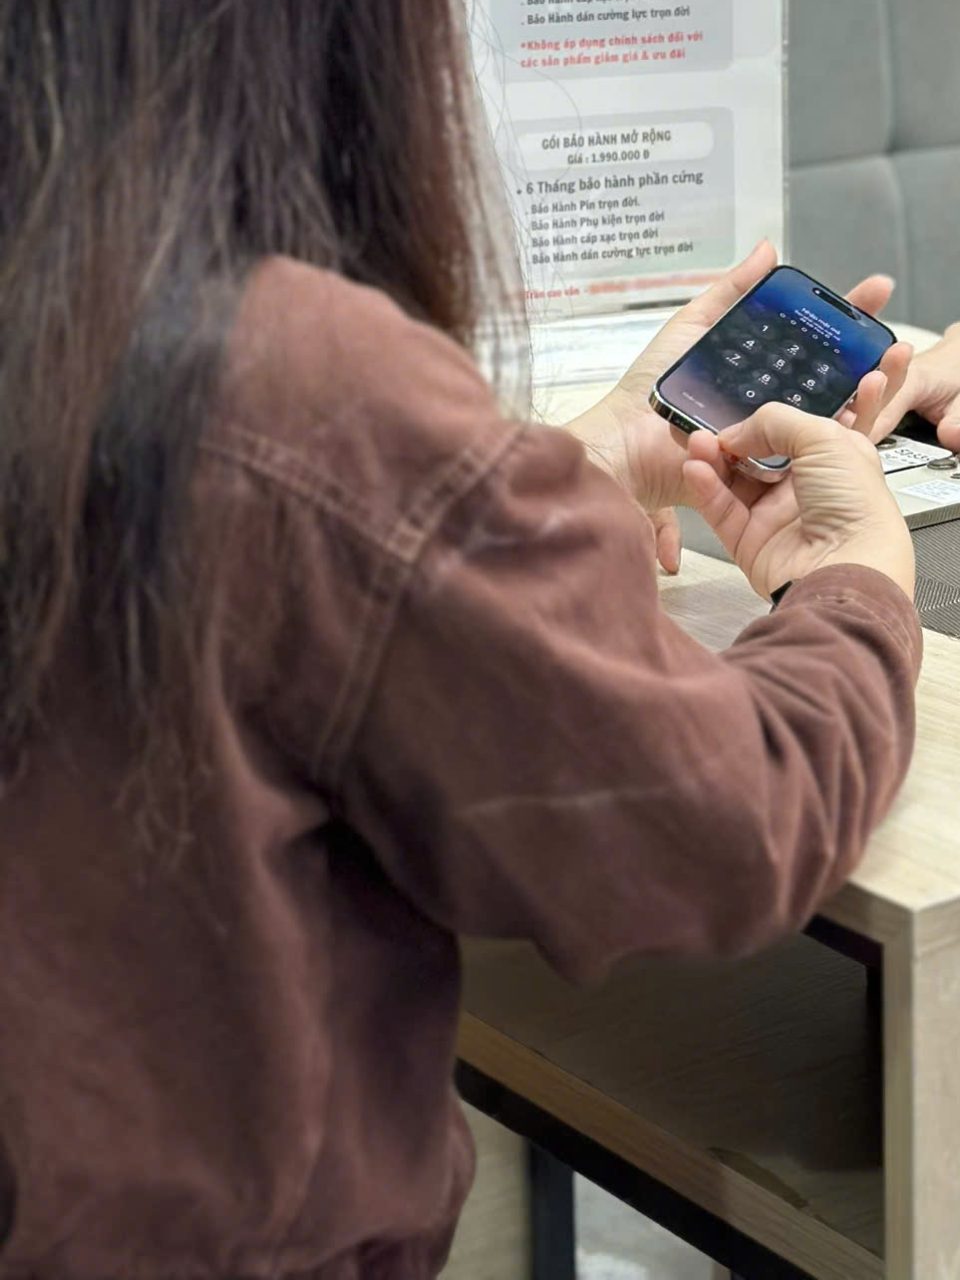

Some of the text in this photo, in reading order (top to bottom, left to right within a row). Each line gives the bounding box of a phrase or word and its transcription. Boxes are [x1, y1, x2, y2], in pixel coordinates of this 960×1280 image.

[548, 12, 573, 24] Hành
[541, 134, 560, 150] GÓI
[587, 131, 617, 147] HÀNH
[642, 127, 672, 145] RỘNG
[525, 169, 704, 195] 6 Tháng bảo hành phần cứng
[579, 198, 596, 210] Pin
